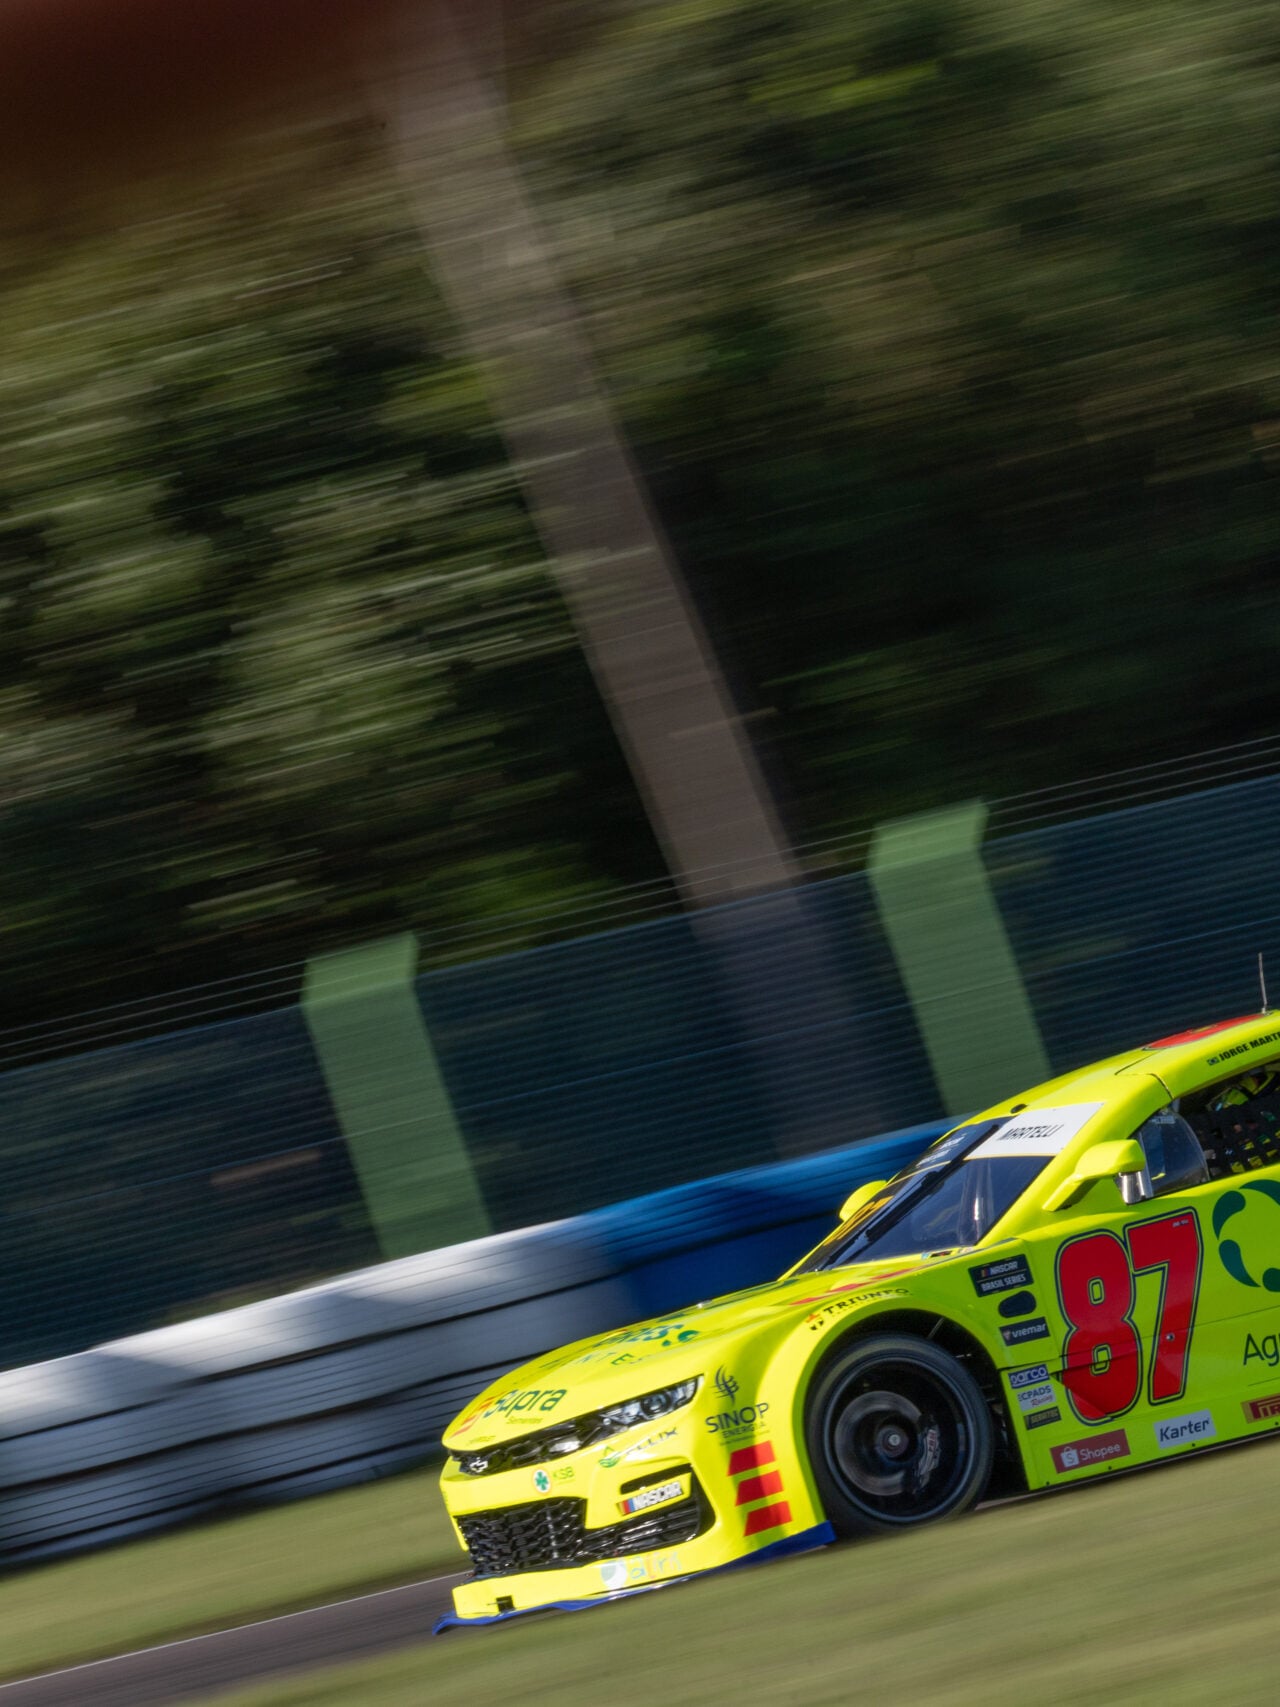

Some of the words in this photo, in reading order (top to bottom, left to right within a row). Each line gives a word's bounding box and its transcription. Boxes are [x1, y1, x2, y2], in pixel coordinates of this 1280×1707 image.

[1219, 1043, 1250, 1062] JORGE
[989, 1261, 1019, 1276] NASCAR
[981, 1279, 1005, 1292] BRASIL
[1005, 1273, 1027, 1286] SERIES
[823, 1288, 910, 1314] TRIUNFO
[1054, 1206, 1204, 1427] 87
[705, 1402, 769, 1434] SINOP
[1159, 1417, 1211, 1443] Karter
[1080, 1443, 1121, 1461] Shopee
[632, 1481, 683, 1511] NASCAR
